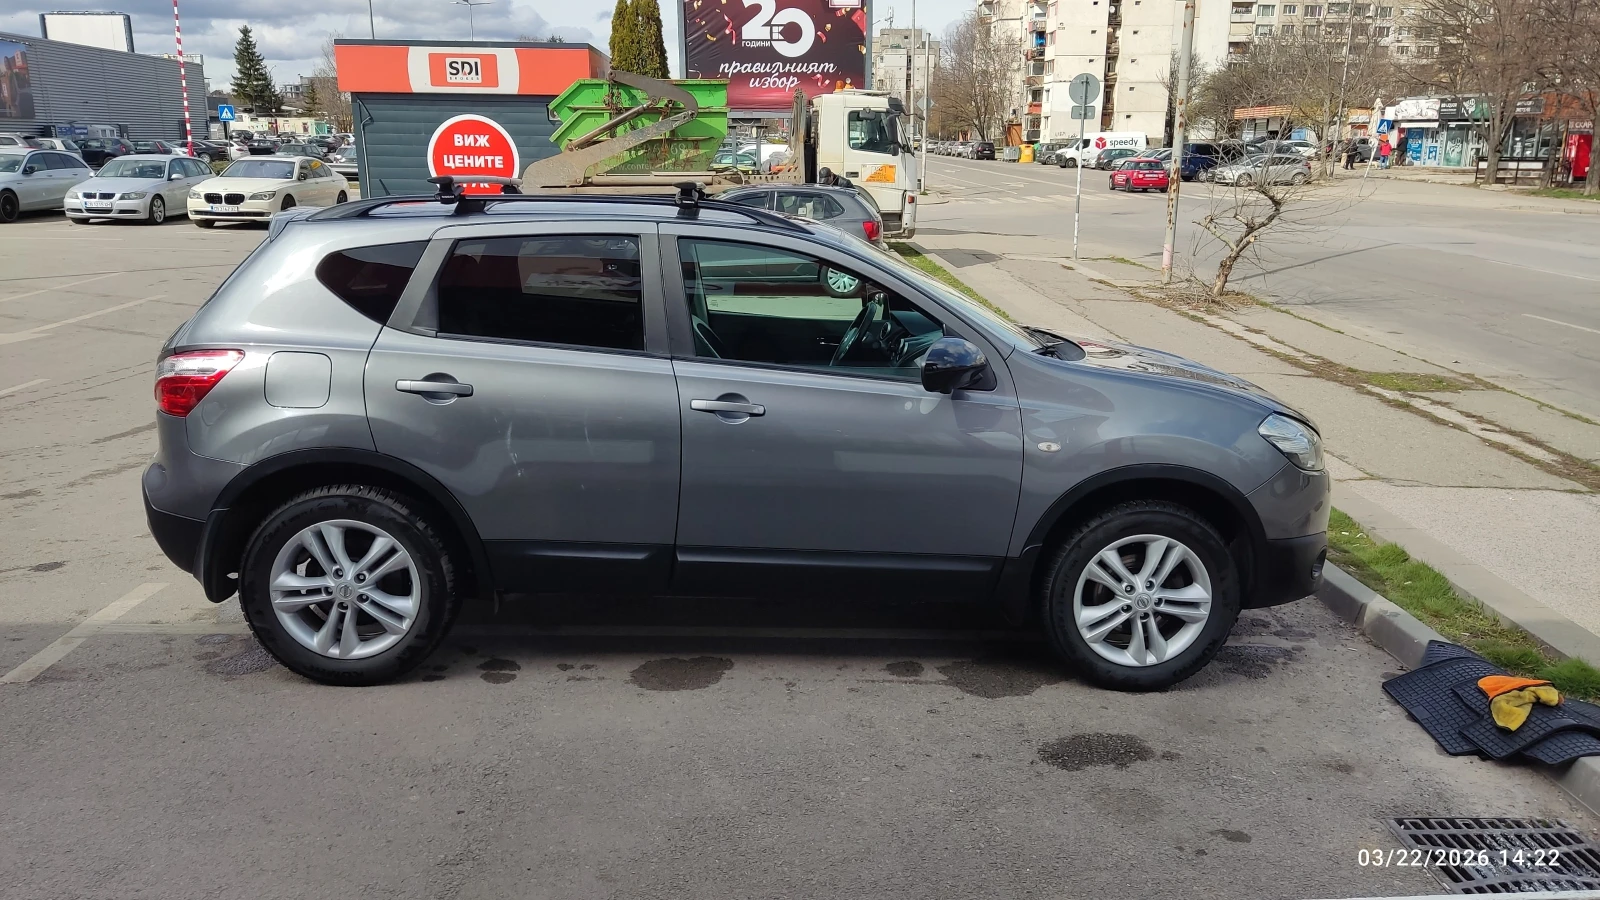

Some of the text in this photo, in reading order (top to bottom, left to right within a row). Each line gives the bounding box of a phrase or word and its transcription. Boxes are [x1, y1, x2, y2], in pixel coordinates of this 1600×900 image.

[741, 0, 815, 57] 20
[741, 40, 771, 48] ГОДИНИ
[448, 60, 480, 76] SDI
[719, 60, 837, 78] правилният
[749, 73, 801, 92] избор
[453, 133, 490, 147] ВИЖ
[1109, 138, 1139, 148] speedy
[443, 154, 504, 169] ЦЕНИТЕ
